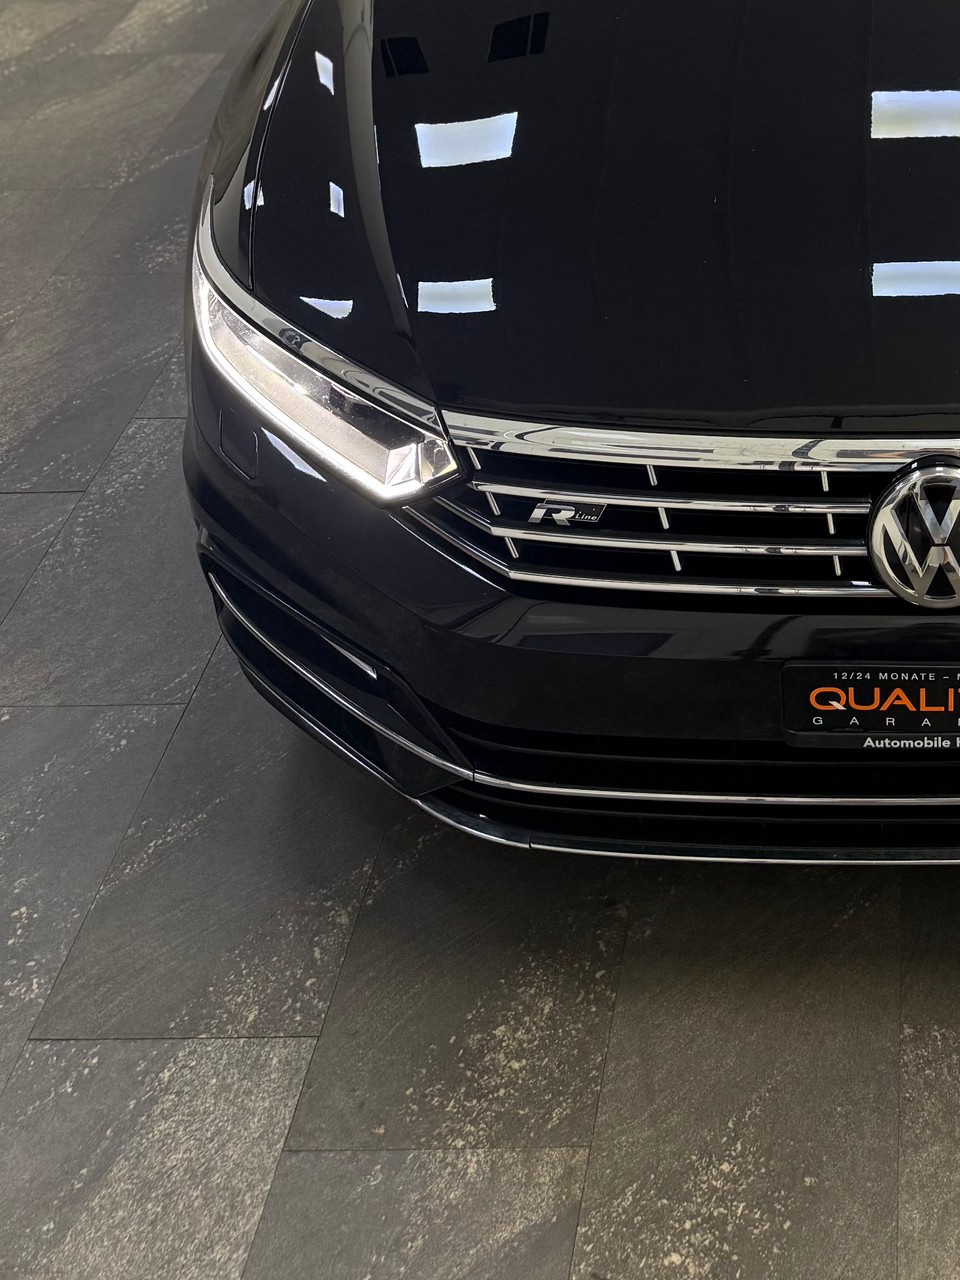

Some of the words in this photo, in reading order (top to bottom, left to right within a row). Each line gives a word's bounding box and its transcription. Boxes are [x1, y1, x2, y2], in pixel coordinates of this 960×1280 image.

[528, 503, 576, 526] R
[833, 672, 872, 681] 12/24
[878, 672, 937, 681] MONATE
[863, 735, 951, 748] Automobile
